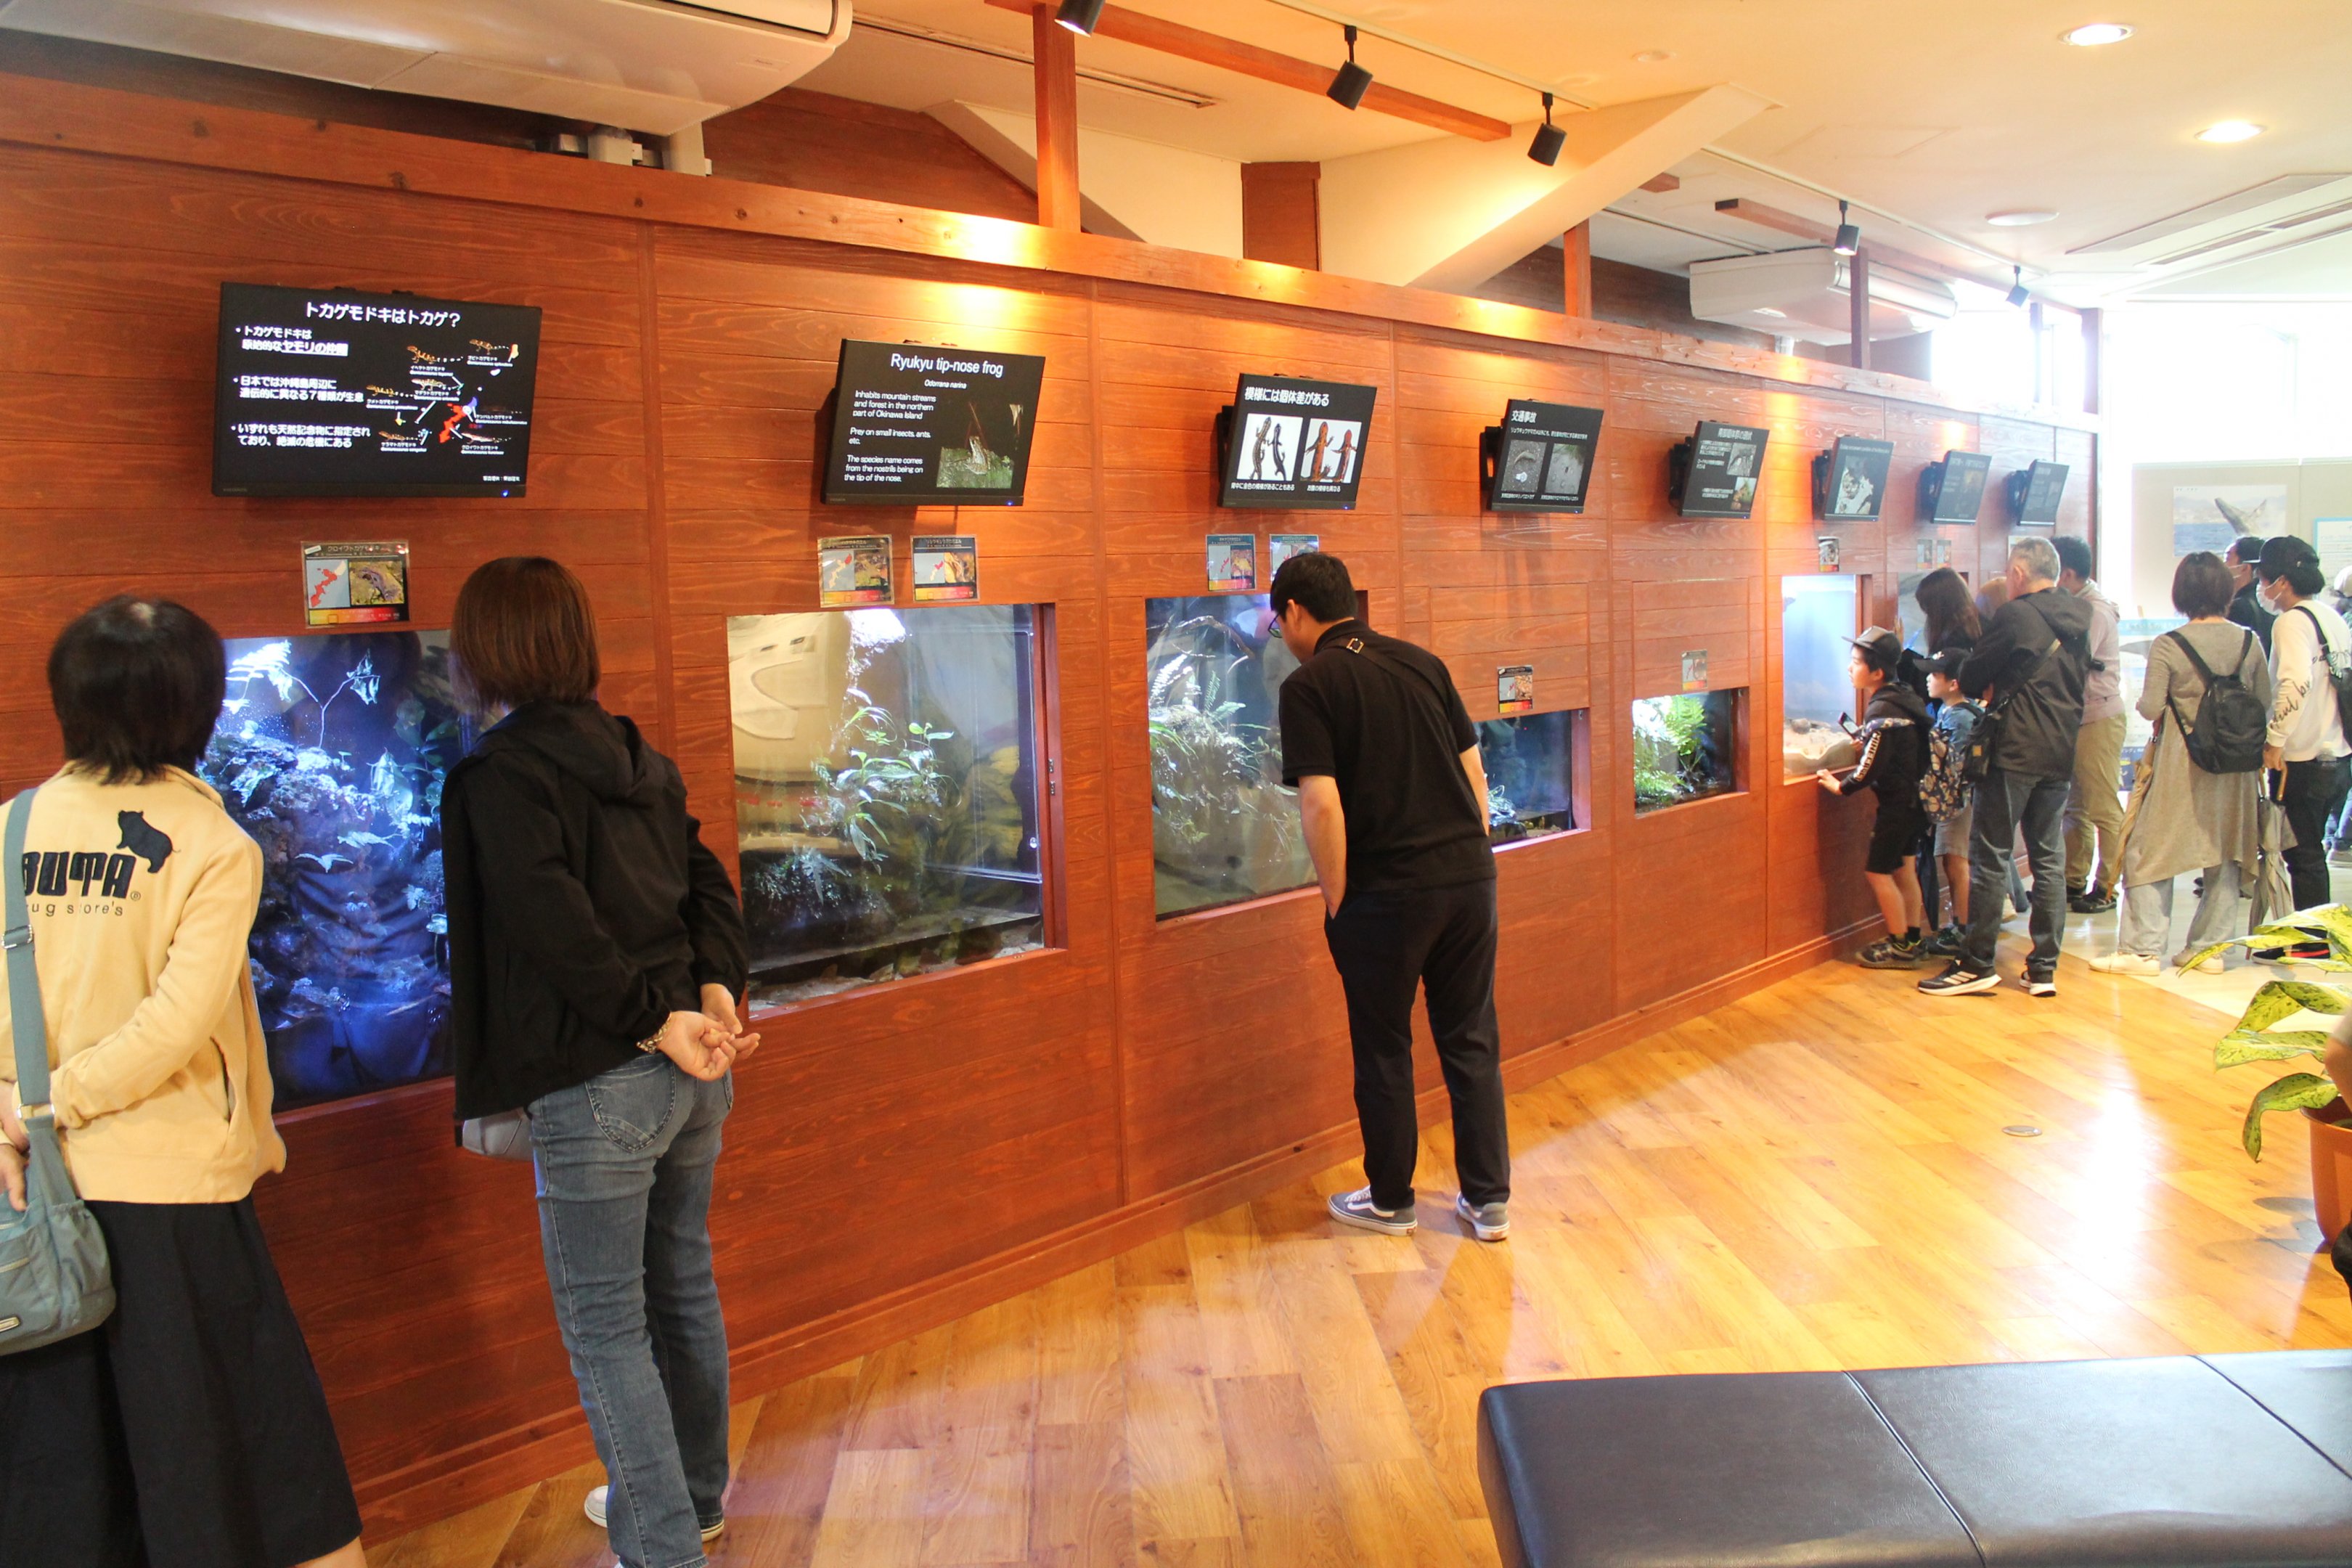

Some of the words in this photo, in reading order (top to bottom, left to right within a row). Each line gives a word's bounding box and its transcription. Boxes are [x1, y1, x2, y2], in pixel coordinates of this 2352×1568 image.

[306, 302, 460, 327] トカゲモドキはトカゲ？
[244, 325, 312, 340] トカゲモドキは
[891, 353, 934, 372] Ryukyu
[936, 357, 979, 374] tip-nose
[982, 361, 1004, 378] frog
[924, 379, 950, 388] Odorrana
[855, 390, 881, 399] Inhabits
[881, 392, 911, 401] mountain
[1244, 386, 1329, 407] 模様には個体差がある
[1511, 409, 1537, 423] 交通事故
[850, 427, 865, 436] Prey
[846, 454, 859, 463] The
[22, 852, 136, 899] BUTA
